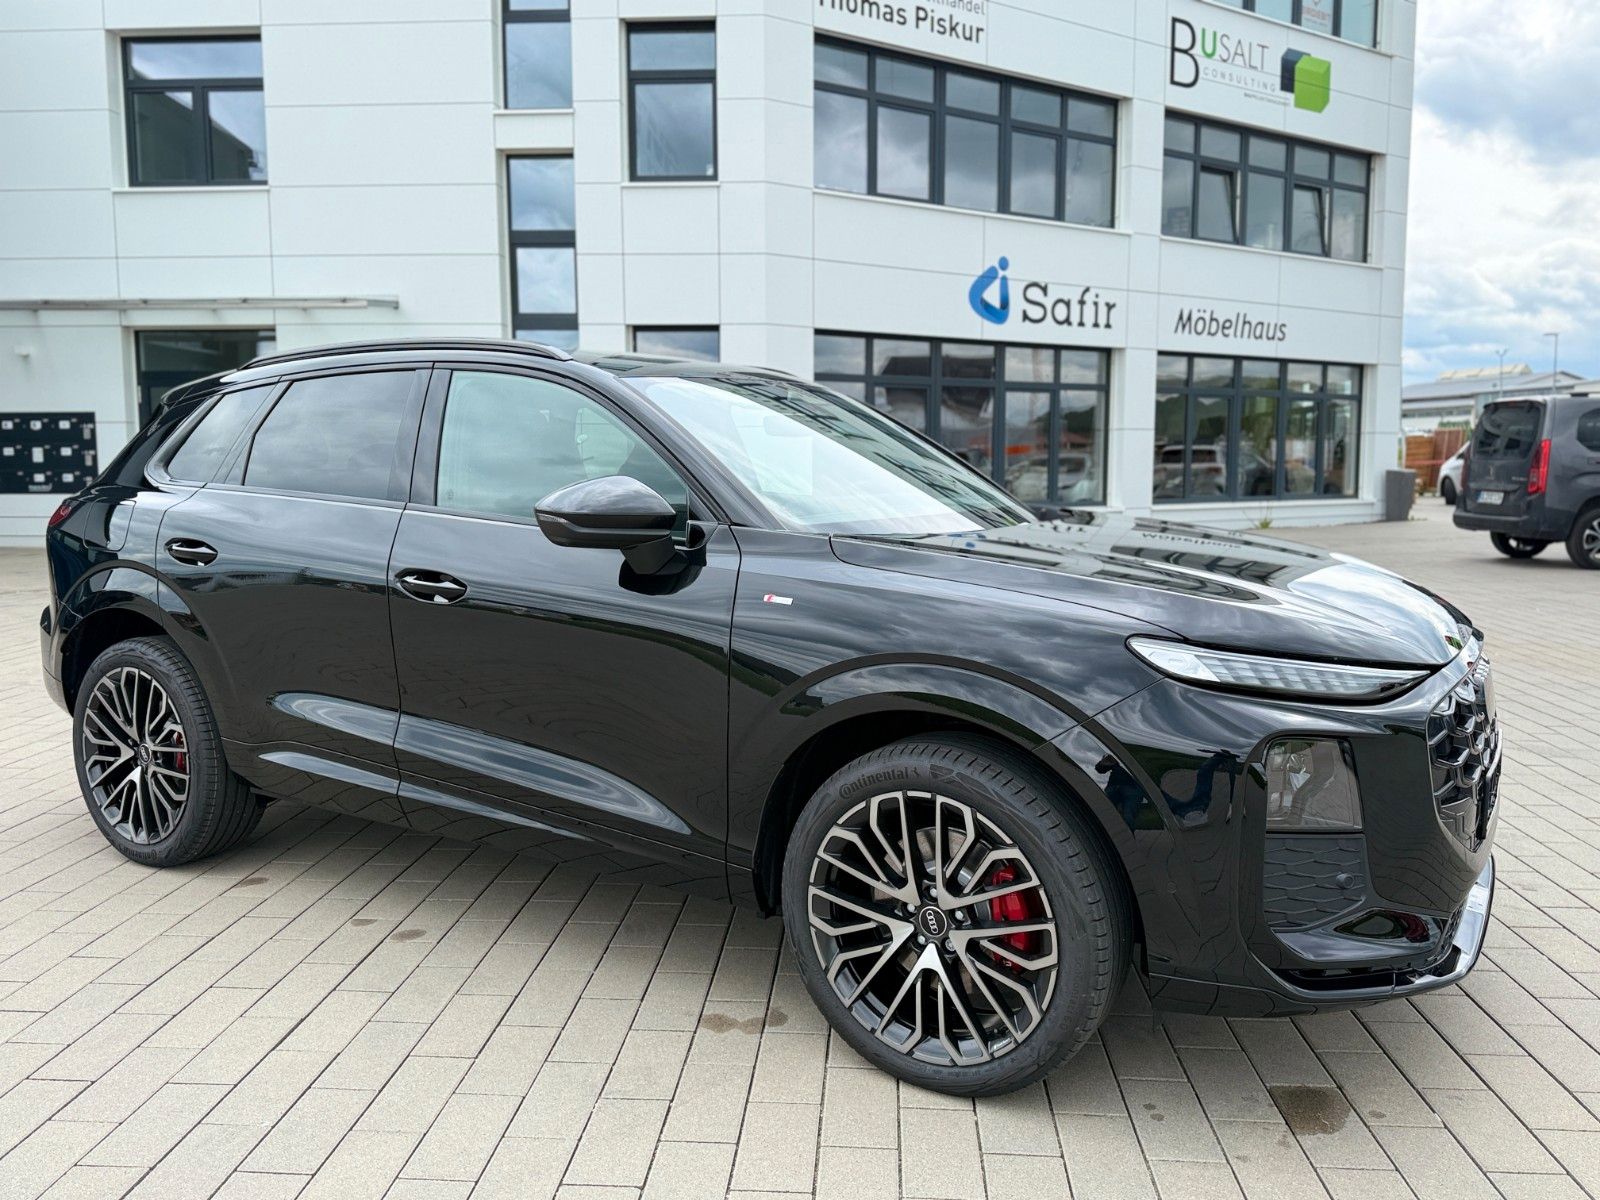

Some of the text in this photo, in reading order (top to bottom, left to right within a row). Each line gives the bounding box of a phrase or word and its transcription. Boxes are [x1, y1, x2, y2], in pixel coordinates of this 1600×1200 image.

[915, 6, 984, 43] Piskur
[1170, 17, 1269, 88] BUSALT
[1203, 66, 1276, 92] CONSULTING
[1022, 281, 1116, 329] Safir
[1174, 307, 1287, 342] Möbelhaus
[839, 766, 908, 799] Continental
